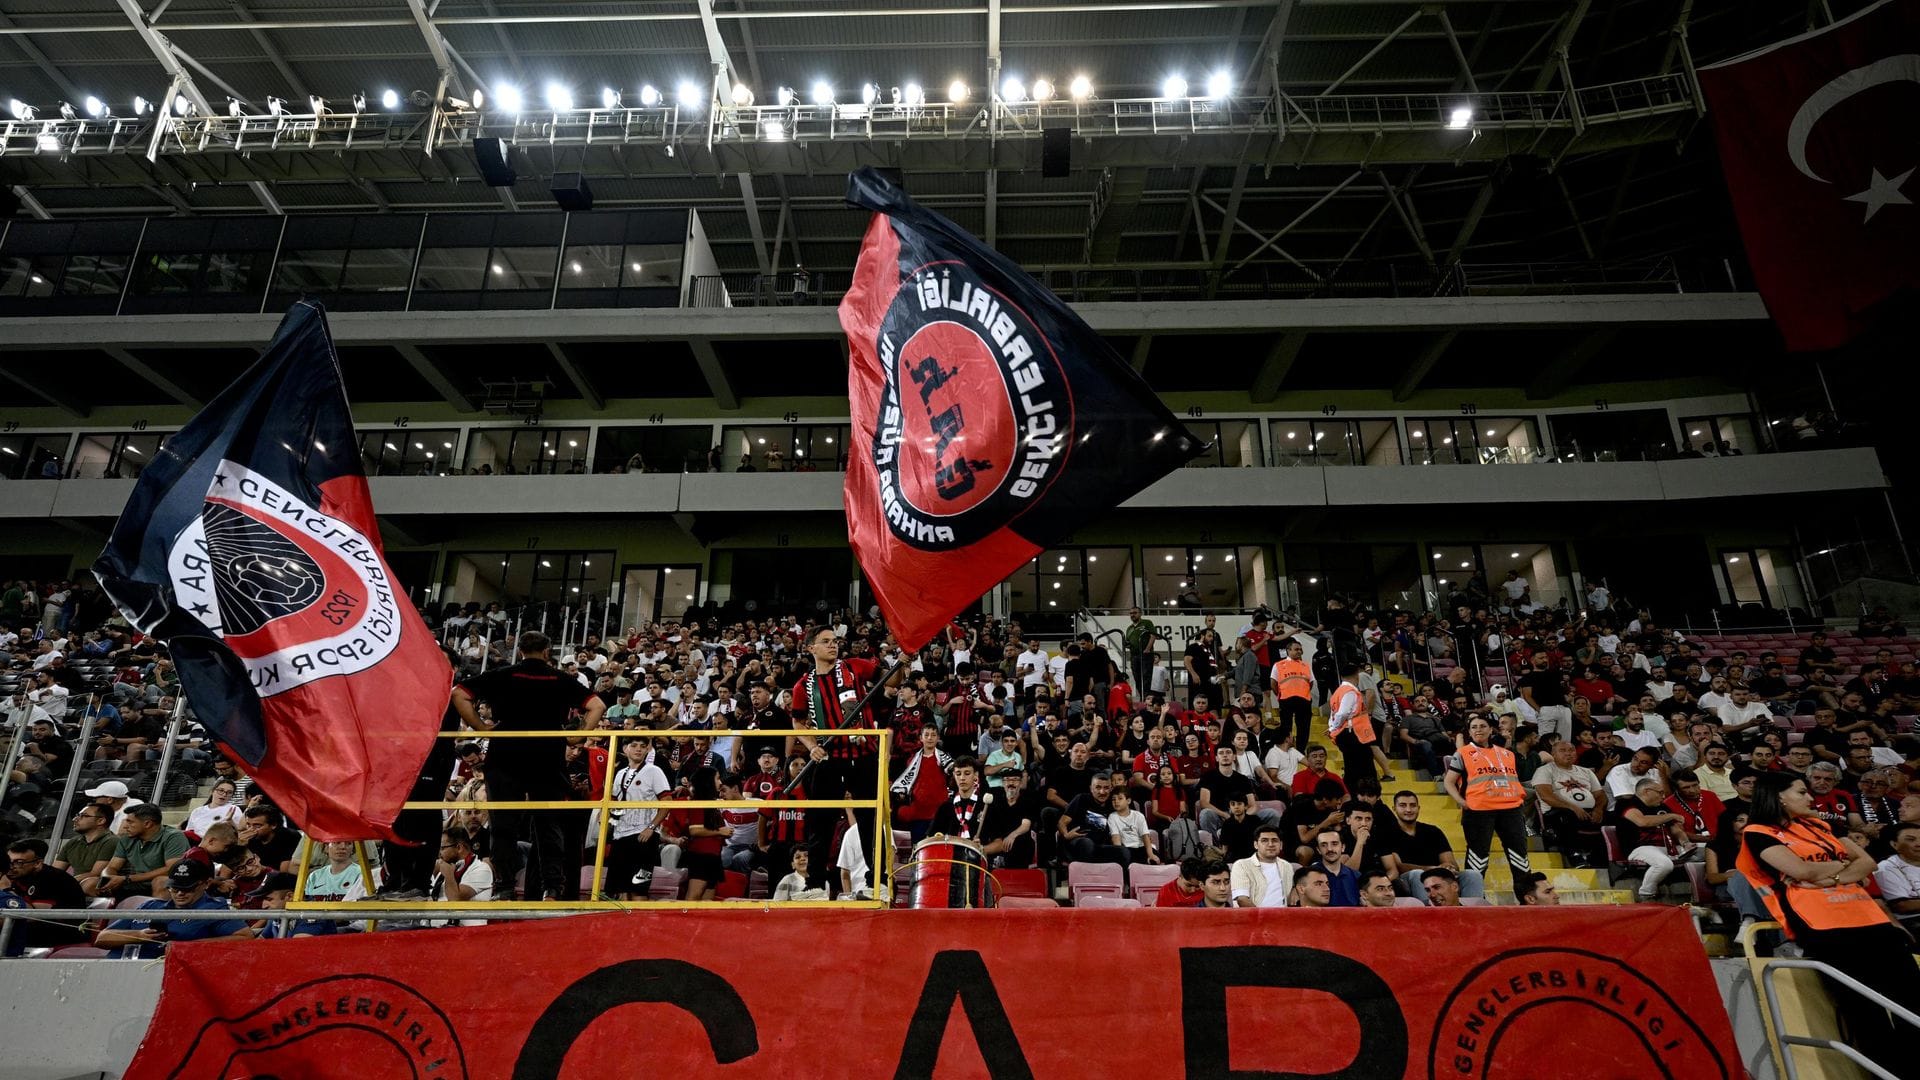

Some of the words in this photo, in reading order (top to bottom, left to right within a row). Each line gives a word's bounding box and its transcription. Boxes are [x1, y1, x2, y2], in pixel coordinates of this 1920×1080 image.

[1460, 403, 1476, 414] 50
[1595, 399, 1608, 410] 51
[1188, 406, 1203, 417] 48
[1322, 405, 1337, 416] 49
[394, 416, 409, 427] 42
[649, 413, 663, 424] 44
[784, 412, 798, 422] 45
[132, 420, 147, 430] 40
[1200, 528, 1212, 542] 21
